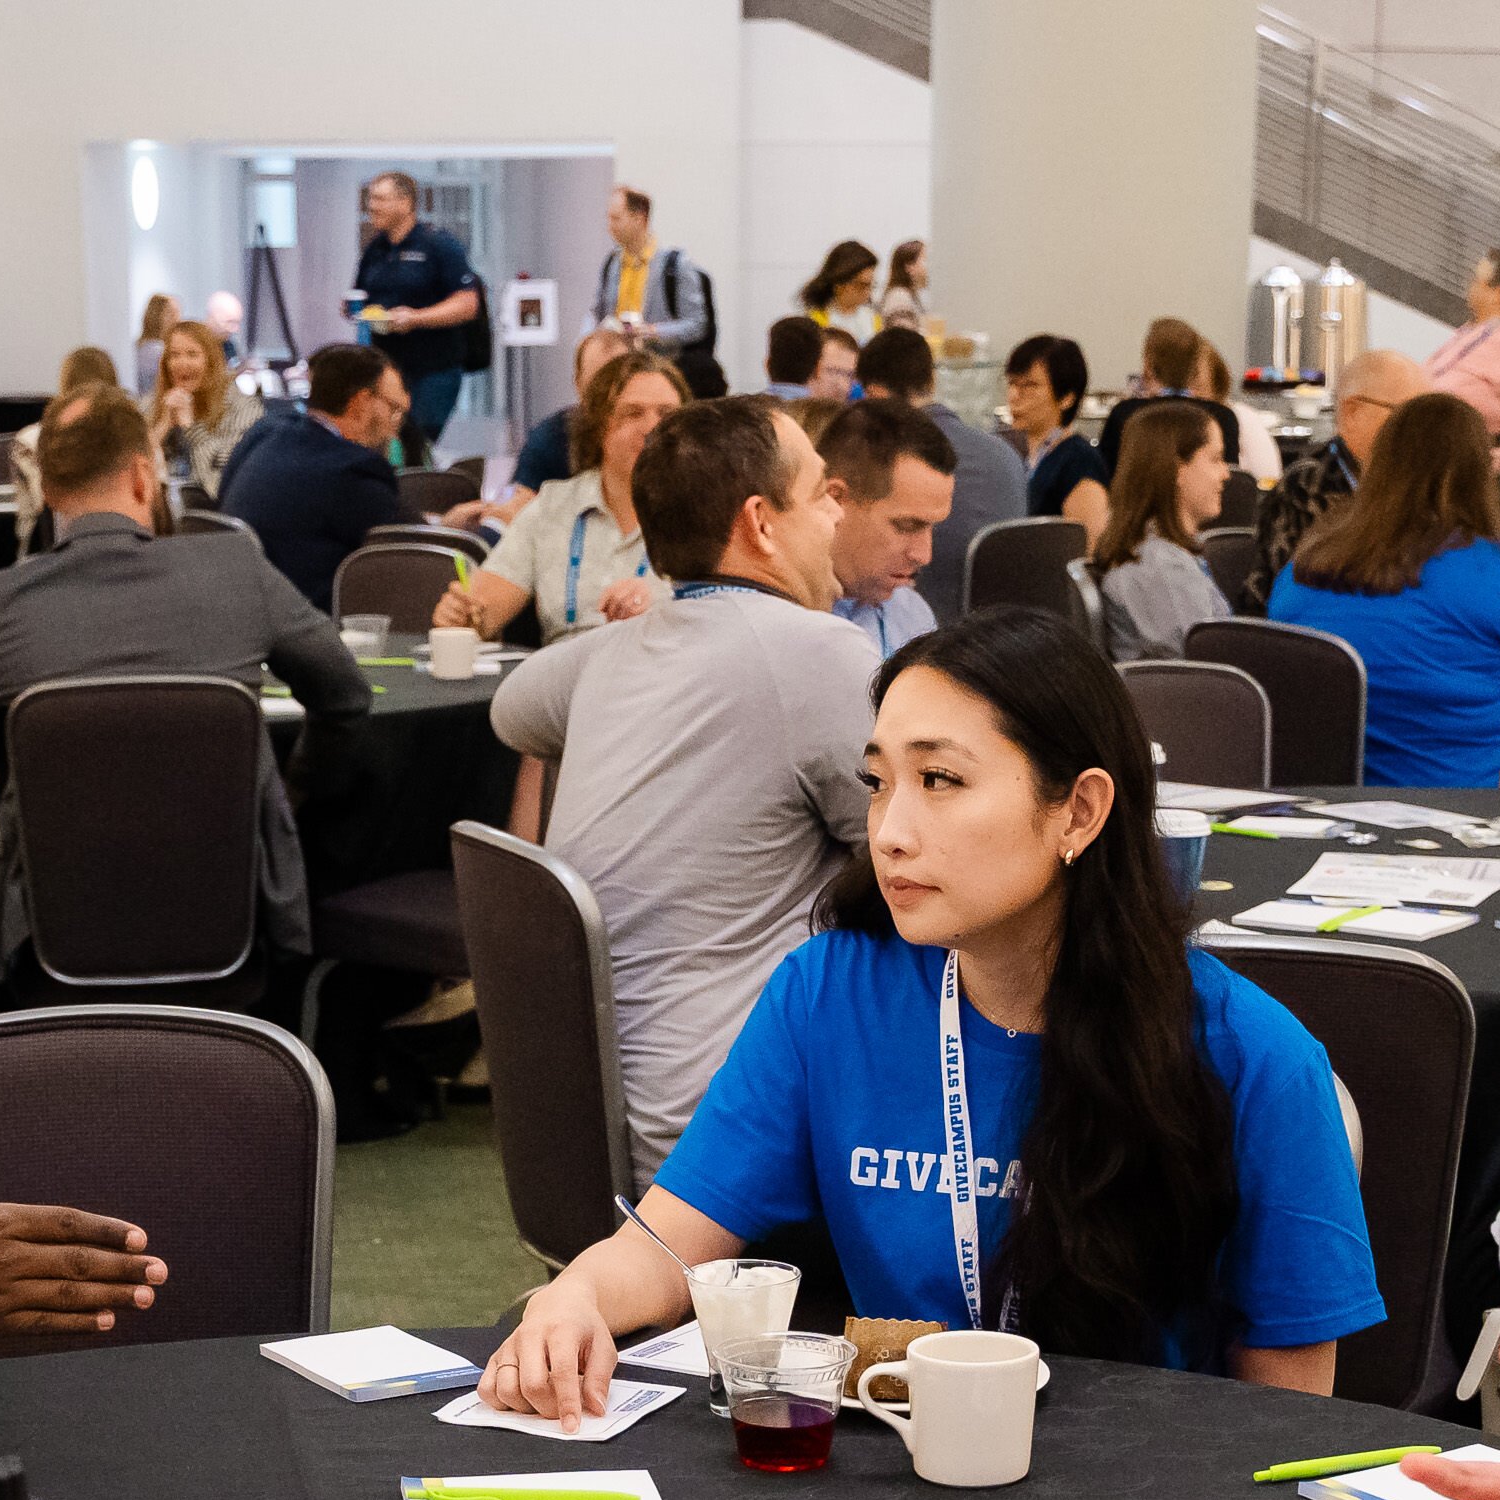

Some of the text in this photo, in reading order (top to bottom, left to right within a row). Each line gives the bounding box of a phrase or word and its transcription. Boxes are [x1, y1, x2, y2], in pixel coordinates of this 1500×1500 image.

[946, 949, 956, 999] GIVEC
[946, 1034, 971, 1203] GIVECAMPUS STAFF
[850, 1146, 1025, 1200] GIVCA
[960, 1237, 976, 1293] STAFF
